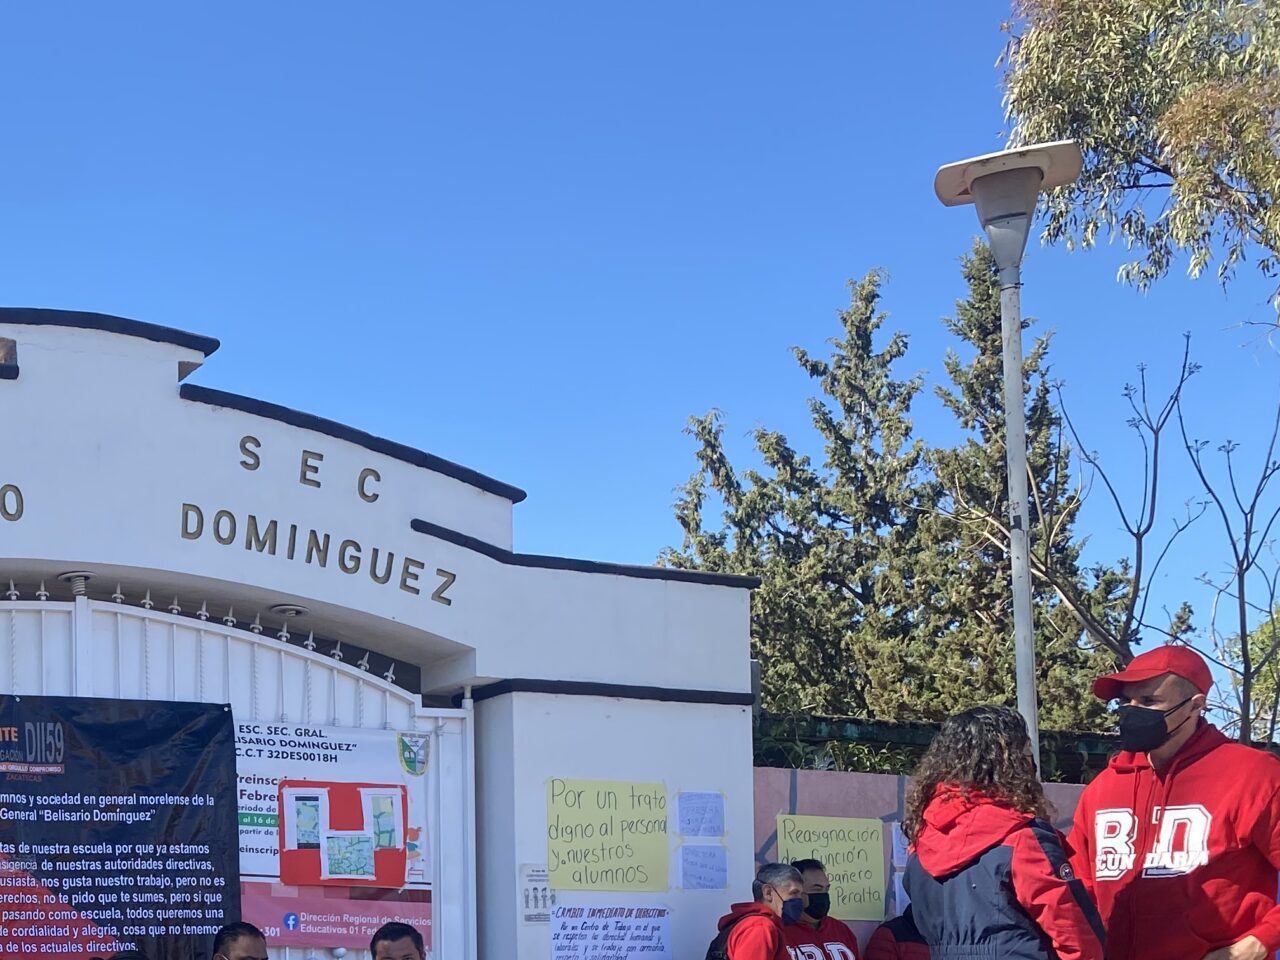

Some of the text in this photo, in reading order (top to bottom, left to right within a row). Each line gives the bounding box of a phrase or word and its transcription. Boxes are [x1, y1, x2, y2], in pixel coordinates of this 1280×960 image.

[240, 436, 381, 503] SEC
[181, 503, 456, 606] DOMINGUEZ
[239, 725, 327, 738] ESC. SEC. GRAL.
[29, 796, 34, 807] y
[37, 793, 81, 805] sociedad
[83, 796, 96, 805] en
[99, 793, 136, 807] general
[139, 793, 189, 805] morelense
[192, 794, 204, 806] de
[206, 794, 214, 806] la
[551, 778, 666, 811] Por un trato
[0, 808, 37, 821] General
[39, 809, 90, 821] “Belisario
[94, 808, 156, 824] Domínguez”
[549, 814, 594, 843] digno
[600, 815, 612, 836] al
[783, 818, 879, 847] Reasignación
[18, 842, 30, 853] de
[32, 844, 70, 855] nuestra
[73, 842, 112, 854] escuela
[116, 845, 132, 857] por
[136, 844, 154, 856] que
[156, 845, 167, 856] ya
[170, 843, 209, 854] estamos
[567, 842, 633, 863] nuestros
[41, 860, 53, 871] de
[56, 860, 101, 871] nuestras
[105, 858, 163, 870] autoridades
[165, 858, 215, 872] directivas,
[41, 877, 59, 887] nos
[63, 877, 92, 890] gusta
[95, 875, 134, 887] nuestro
[137, 875, 173, 889] trabajo,
[175, 876, 197, 888] pero
[200, 876, 211, 886] no
[214, 877, 225, 887] es
[573, 865, 648, 884] alumnos
[836, 886, 881, 907] Peralta
[301, 912, 340, 922] Dirección
[343, 914, 378, 925] Regional
[381, 916, 392, 924] de
[301, 924, 358, 934] Educativos 01
[6, 941, 18, 952] de
[22, 942, 37, 953] los
[40, 940, 83, 953] actuales
